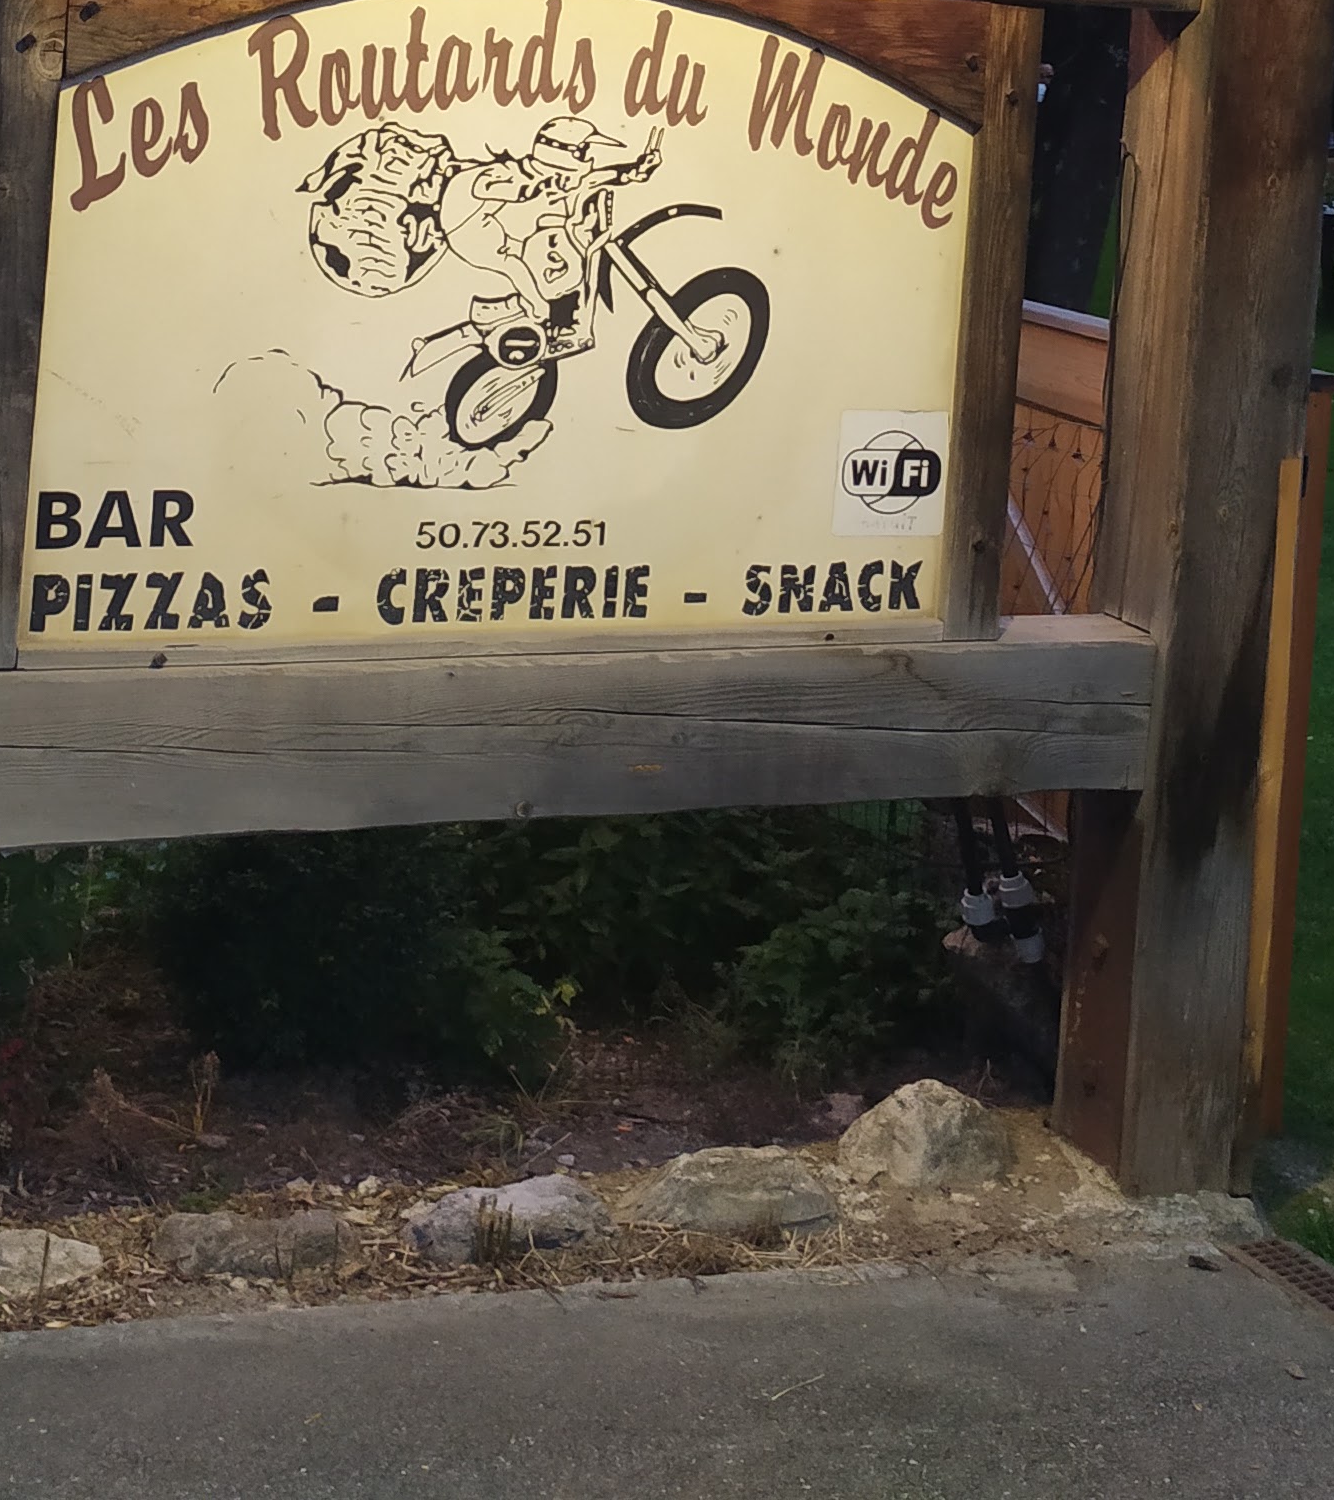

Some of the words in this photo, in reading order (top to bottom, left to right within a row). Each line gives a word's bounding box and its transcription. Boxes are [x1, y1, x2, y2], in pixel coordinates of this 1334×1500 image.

[68, 74, 210, 213] Les
[623, 8, 709, 128] du
[746, 33, 959, 231] Monde
[34, 489, 195, 550] BAR
[414, 520, 608, 550] 50.73.52.51
[28, 567, 273, 633] PIZZAS
[375, 563, 651, 626] CREPERIE
[741, 558, 924, 617] SNACK
